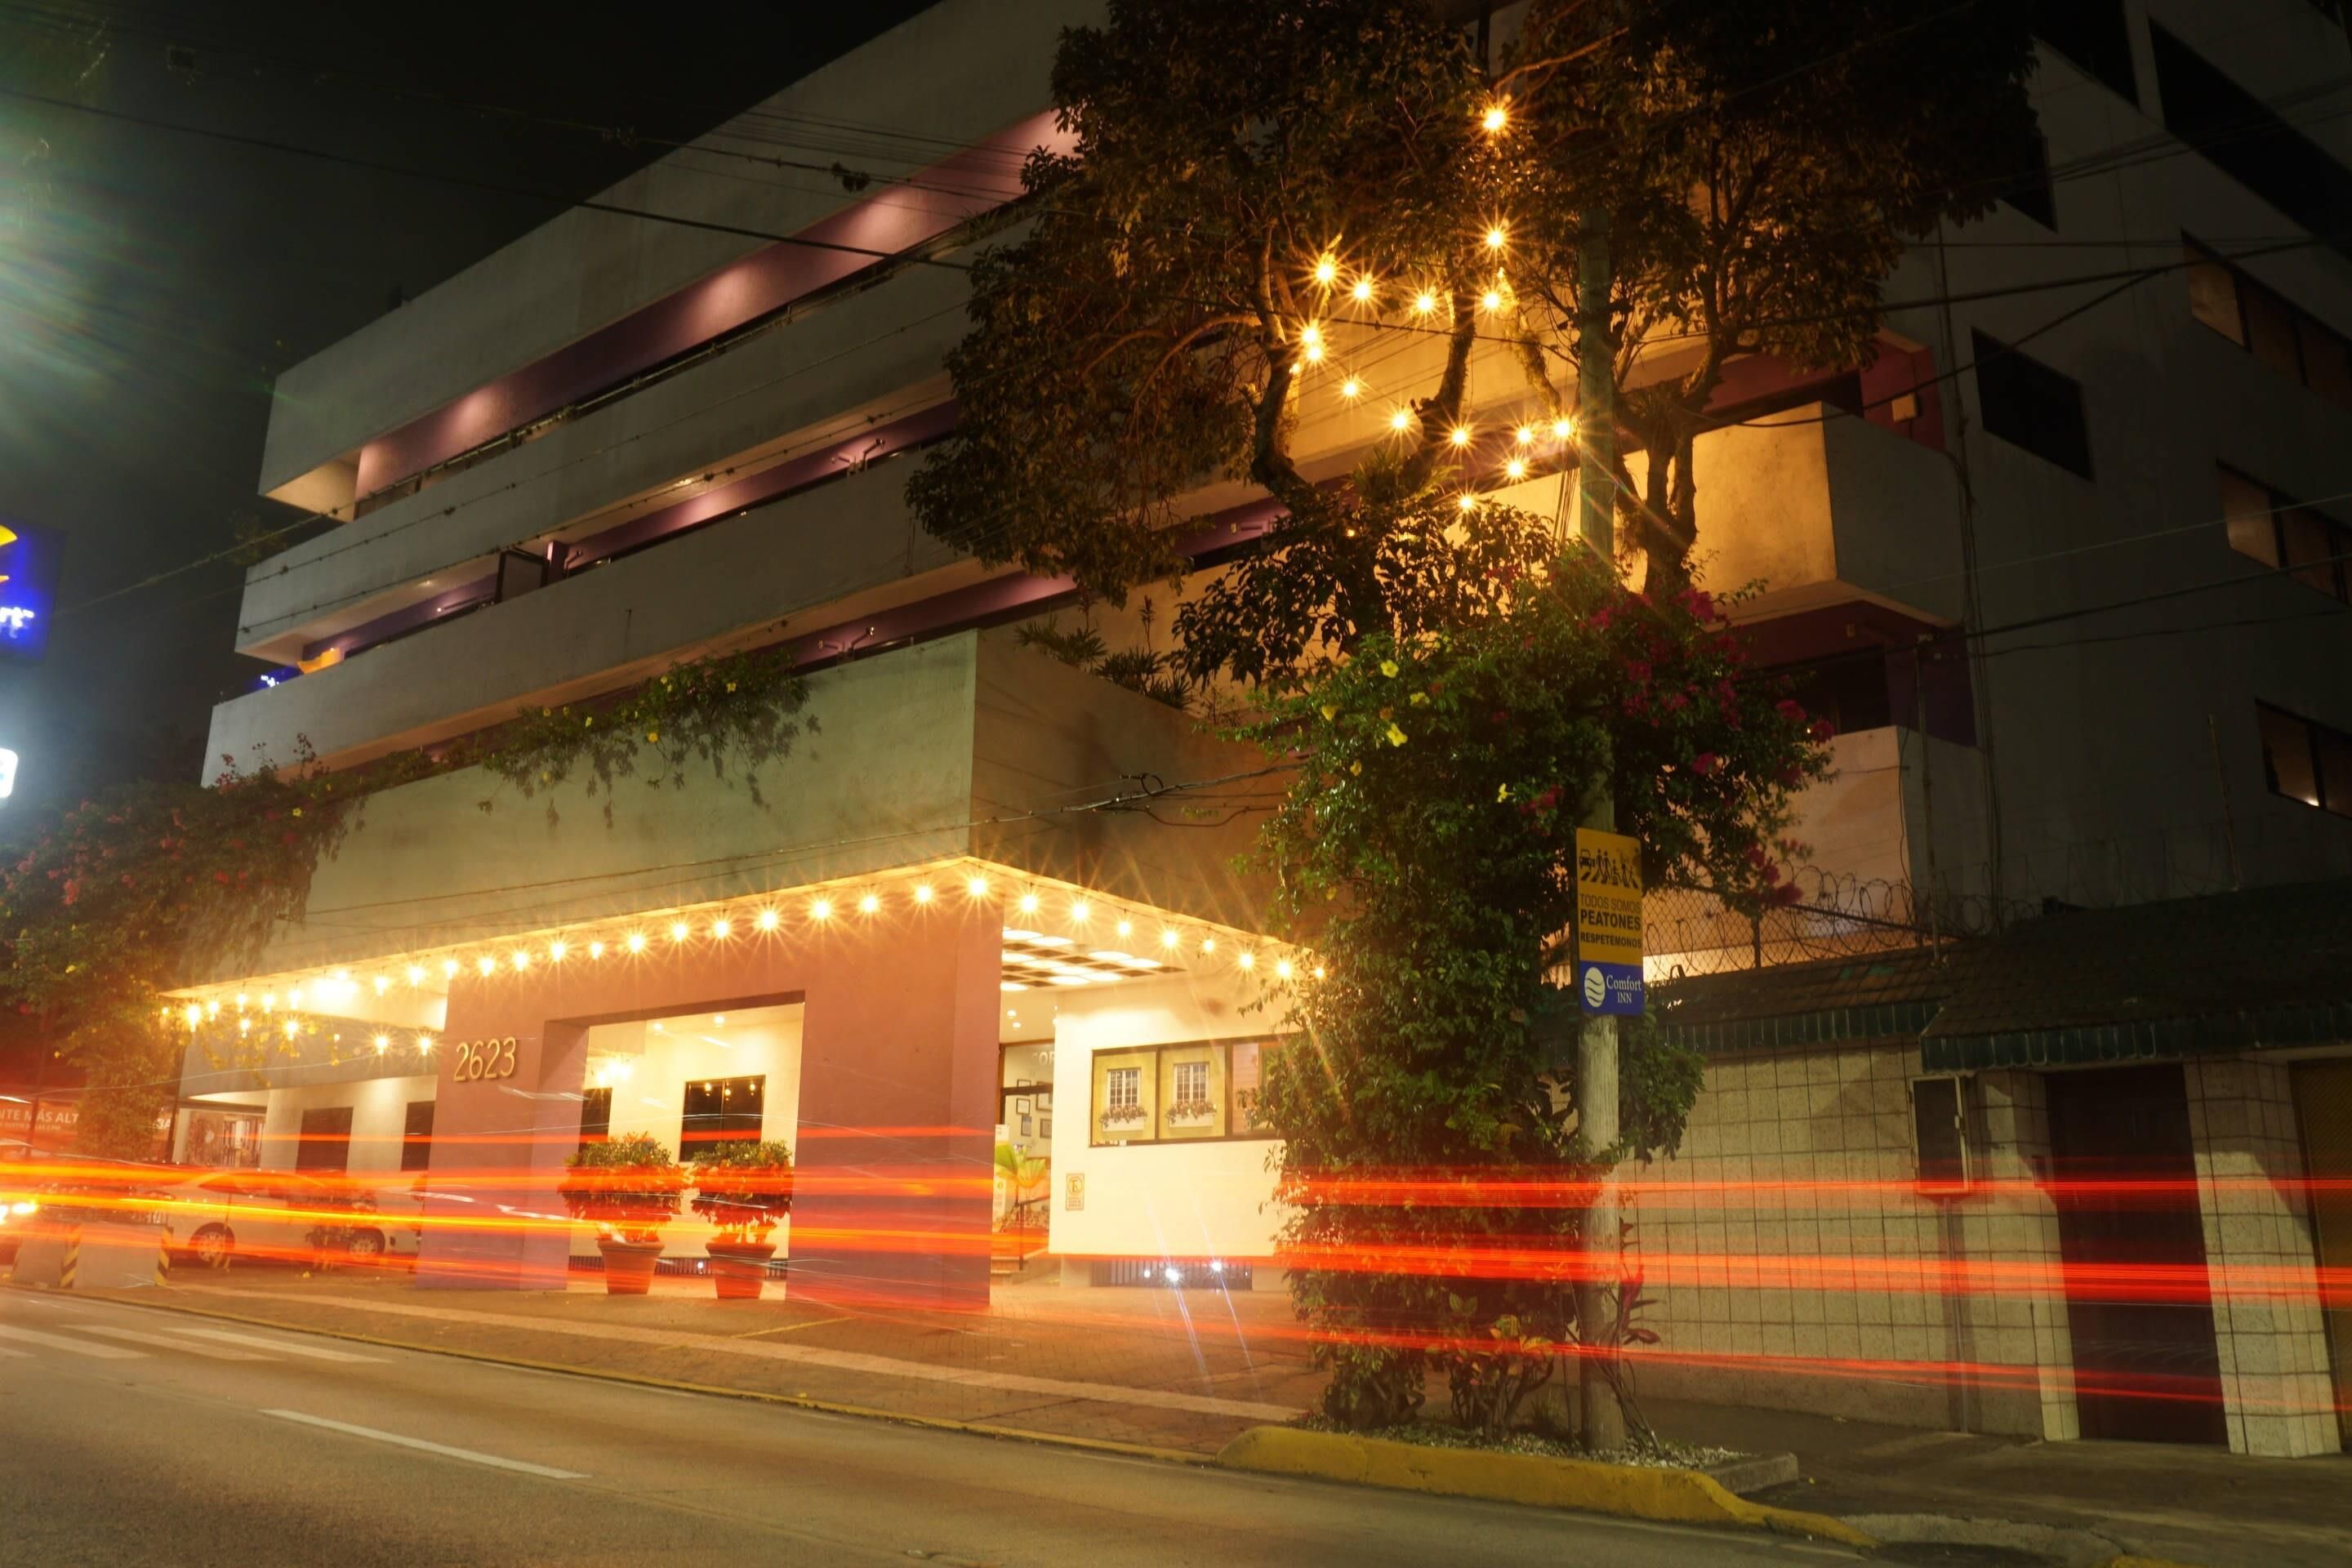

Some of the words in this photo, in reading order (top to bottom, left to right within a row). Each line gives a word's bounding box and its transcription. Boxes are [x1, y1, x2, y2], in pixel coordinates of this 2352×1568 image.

[1580, 893, 1609, 909] TODOS
[1611, 898, 1641, 914] SOMOS
[1580, 909, 1641, 931] PEATONES
[1606, 974, 1642, 991] Comfort
[1617, 991, 1633, 1004] INN
[453, 1036, 516, 1081] 2623
